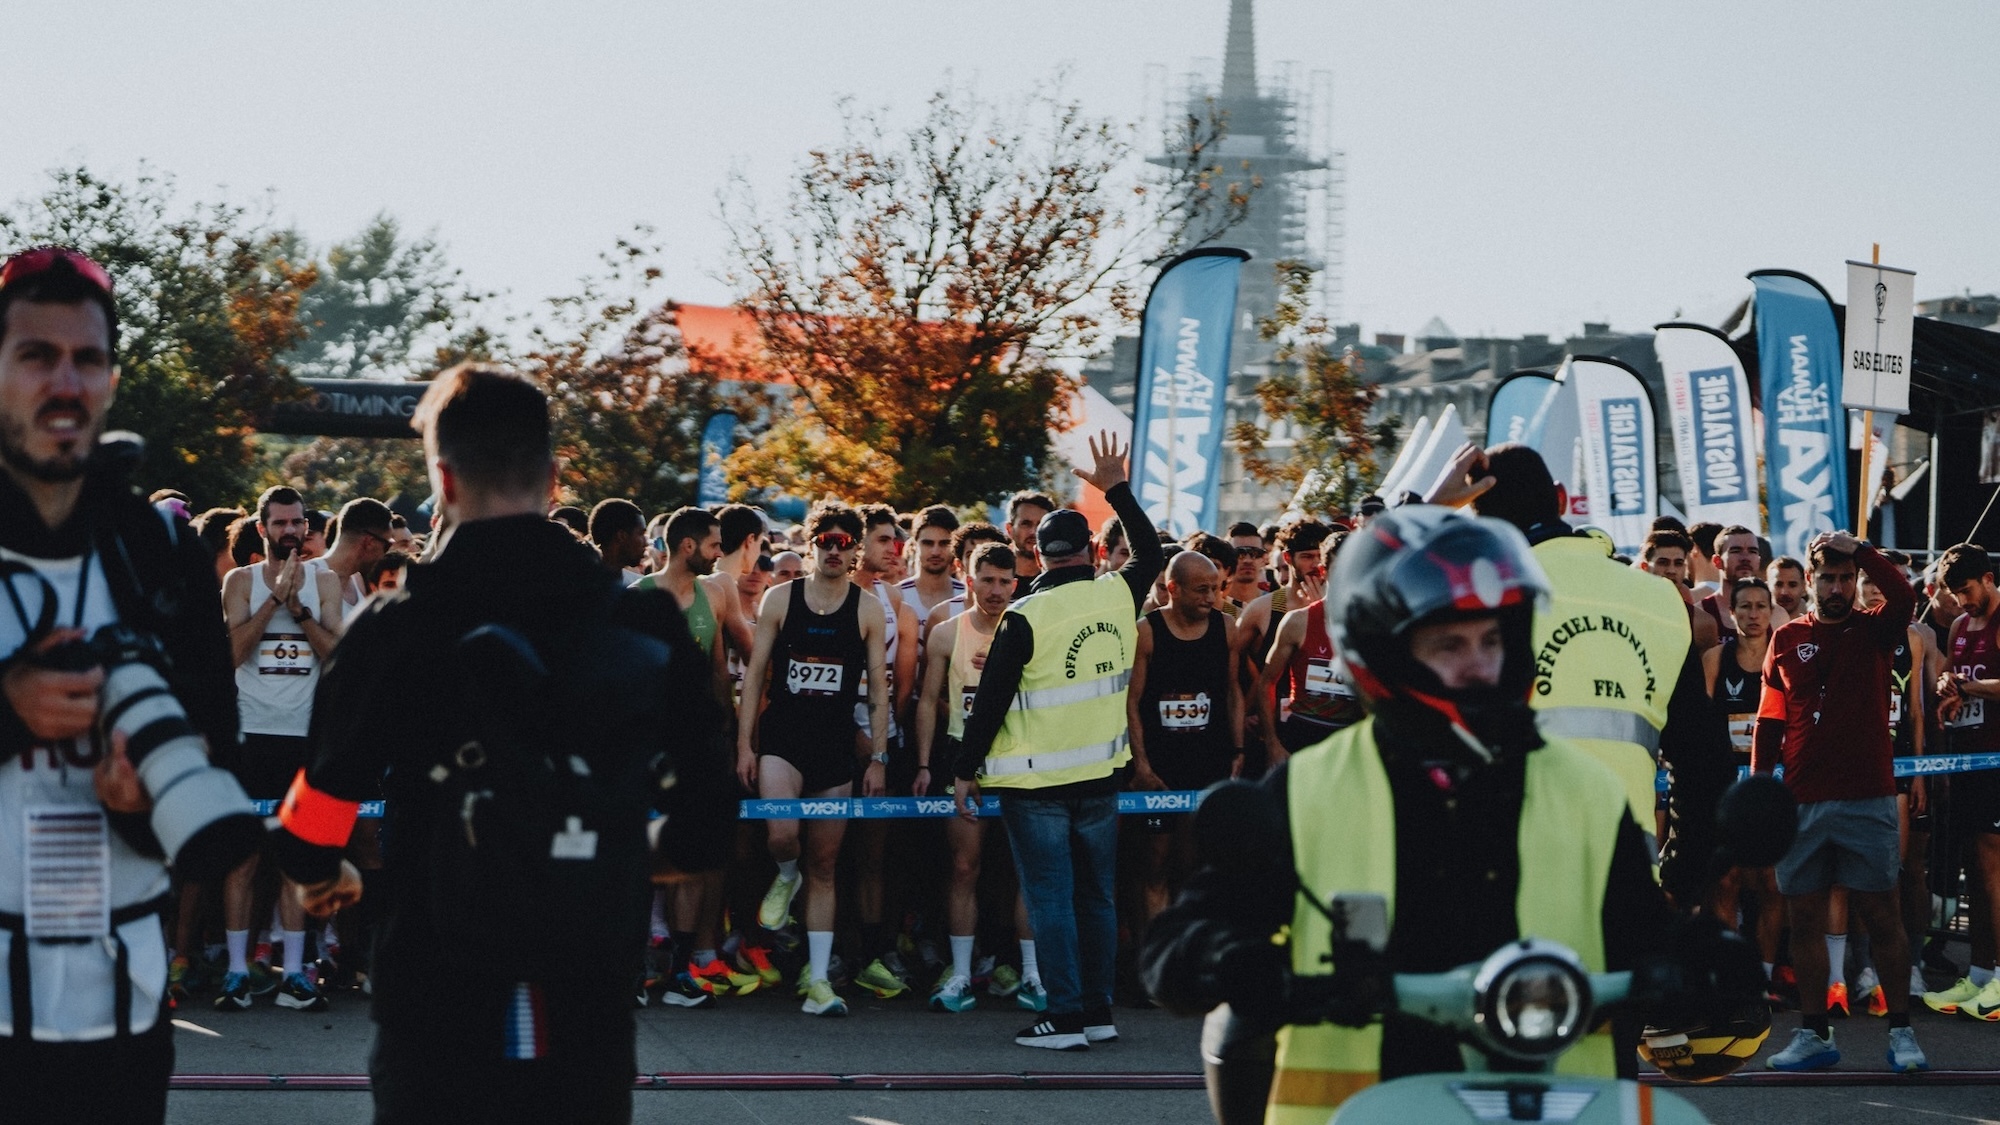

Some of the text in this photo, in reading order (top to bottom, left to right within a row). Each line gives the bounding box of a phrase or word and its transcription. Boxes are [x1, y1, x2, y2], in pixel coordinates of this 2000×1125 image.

[1174, 317, 1200, 409] HUMAN
[1853, 350, 1903, 375] SAS ELITES
[1151, 366, 1173, 406] FLY
[1189, 370, 1214, 411] FLY
[310, 391, 419, 417] OTIMING
[1141, 416, 1211, 542] OKA
[274, 642, 299, 660] 63
[1065, 625, 1095, 679] OFFICIEL
[1536, 616, 1597, 696] OFFICIEL
[789, 663, 837, 683] 6972
[1096, 661, 1114, 674] FFA
[1593, 679, 1626, 699] FFA
[1165, 703, 1209, 719] 1539
[800, 801, 848, 816] HOKA
[1144, 794, 1190, 809] HOKA
